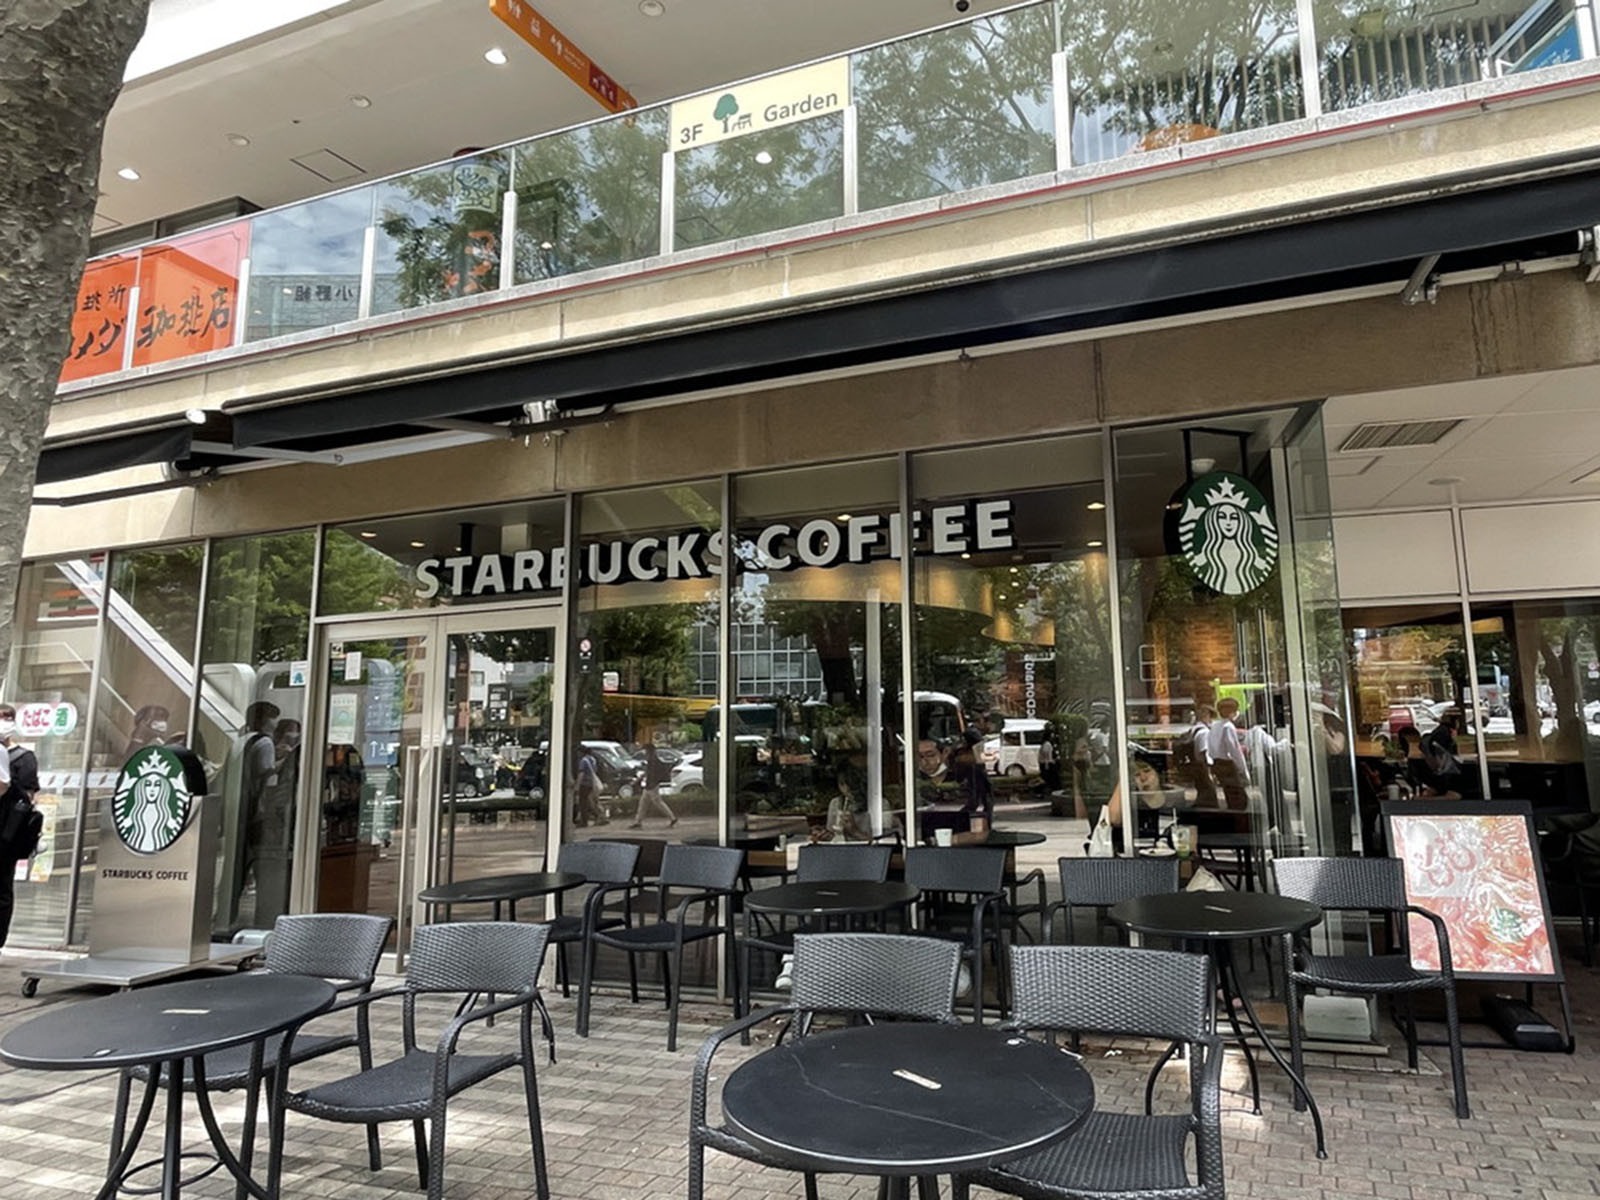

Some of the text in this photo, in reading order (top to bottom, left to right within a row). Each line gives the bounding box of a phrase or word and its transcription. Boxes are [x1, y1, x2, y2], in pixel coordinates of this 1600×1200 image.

[680, 93, 838, 144] 3F Garden
[22, 708, 51, 727] たばこ
[102, 869, 189, 881] STARBUCKS COFFEE
